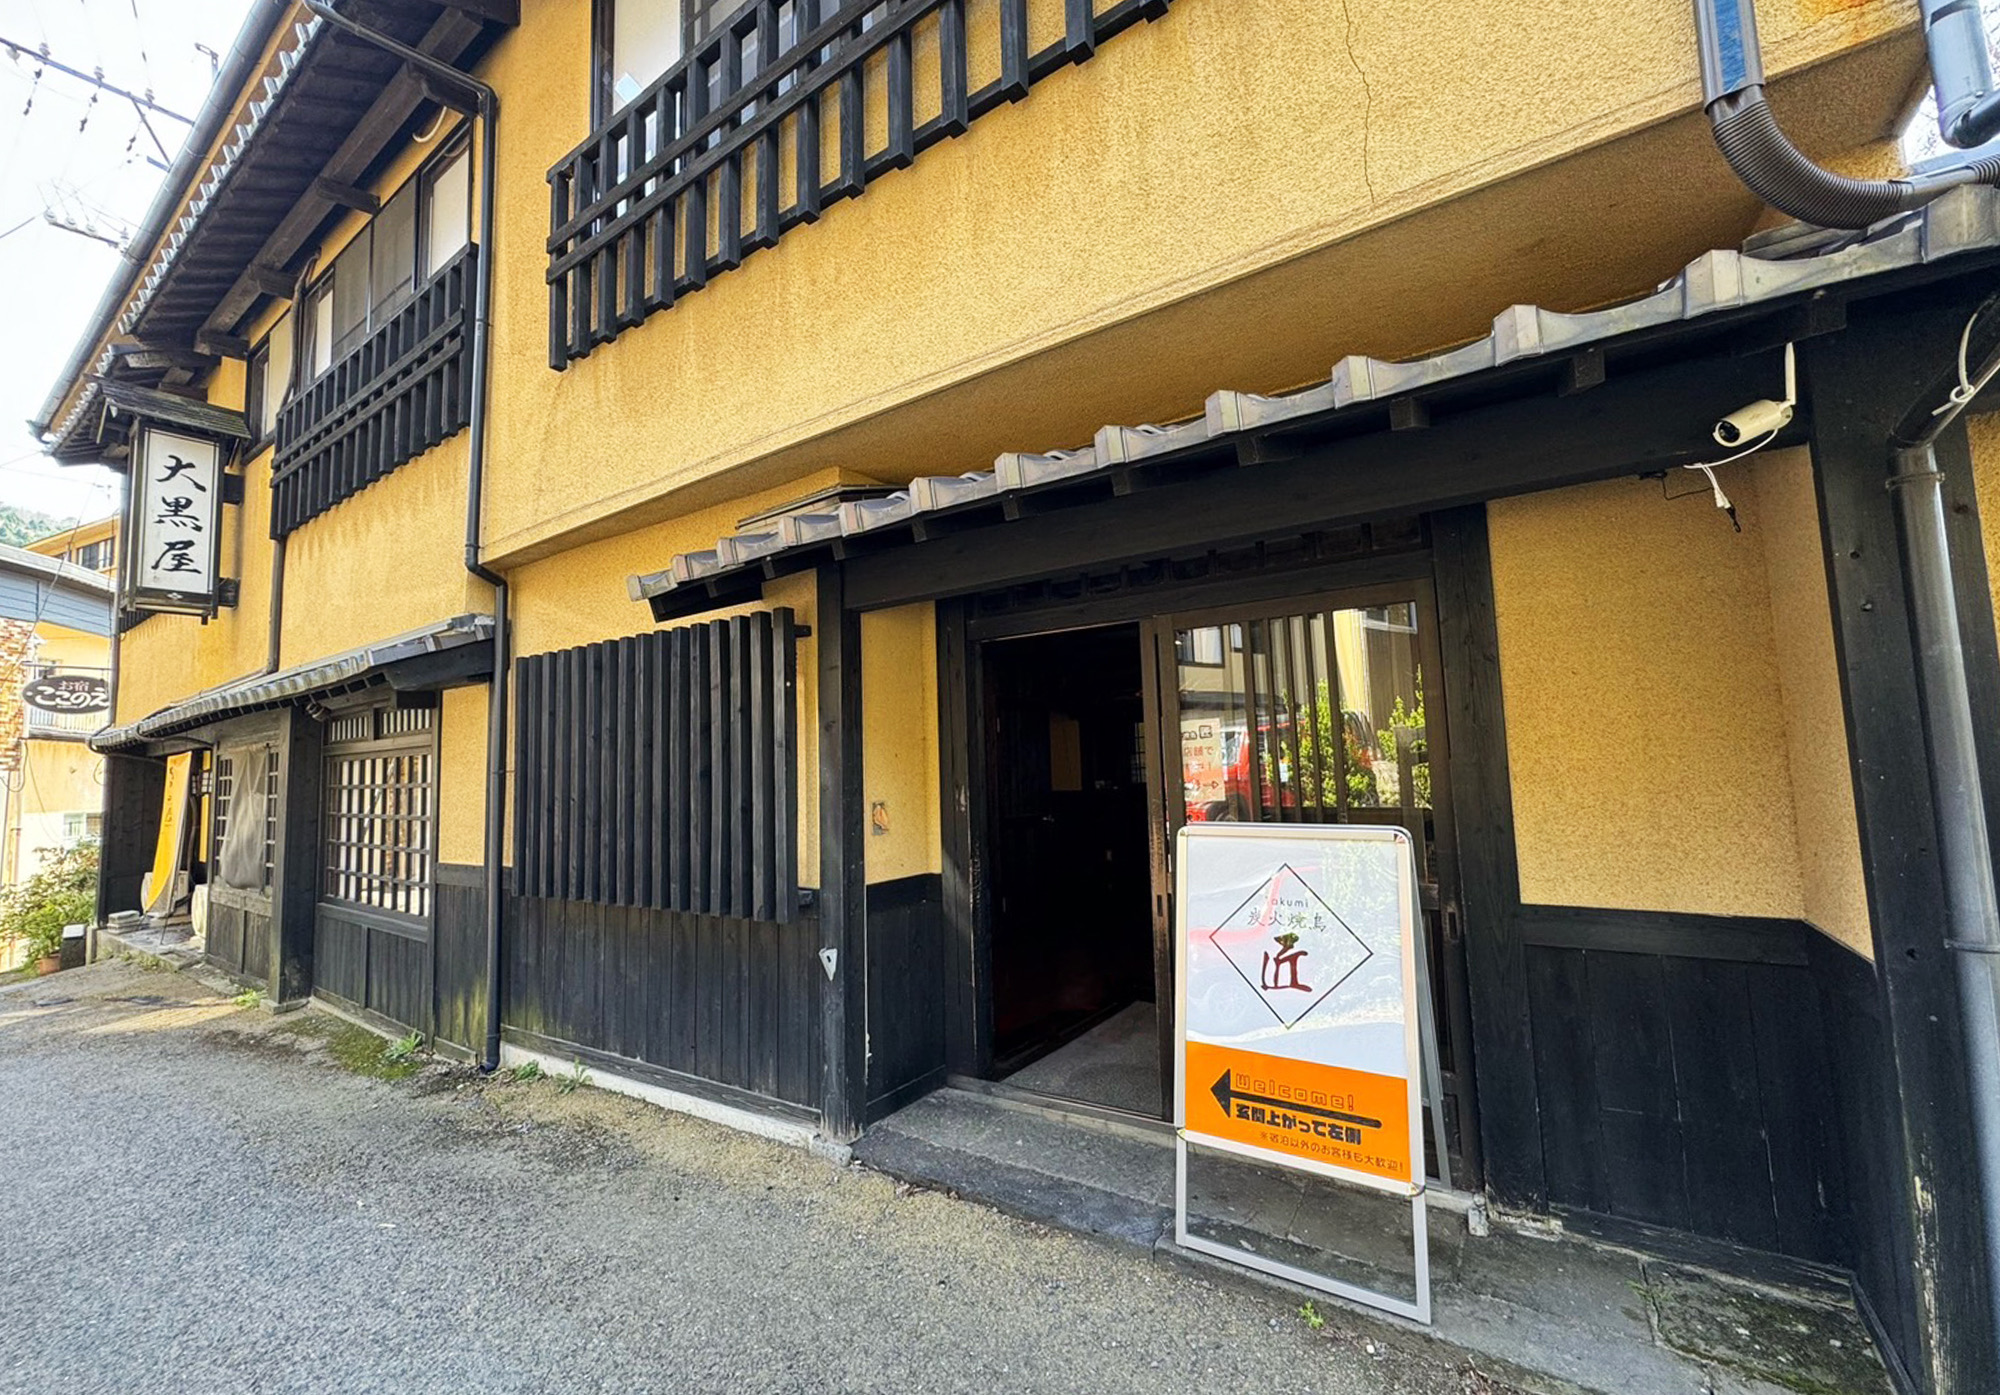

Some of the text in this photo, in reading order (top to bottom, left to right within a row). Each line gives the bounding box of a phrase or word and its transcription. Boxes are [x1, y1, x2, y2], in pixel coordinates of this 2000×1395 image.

[151, 455, 207, 574] 大黒屋
[35, 686, 110, 708] ここのえ
[1261, 932, 1313, 993] 匠
[1235, 1103, 1362, 1145] 玄関上がって左側
